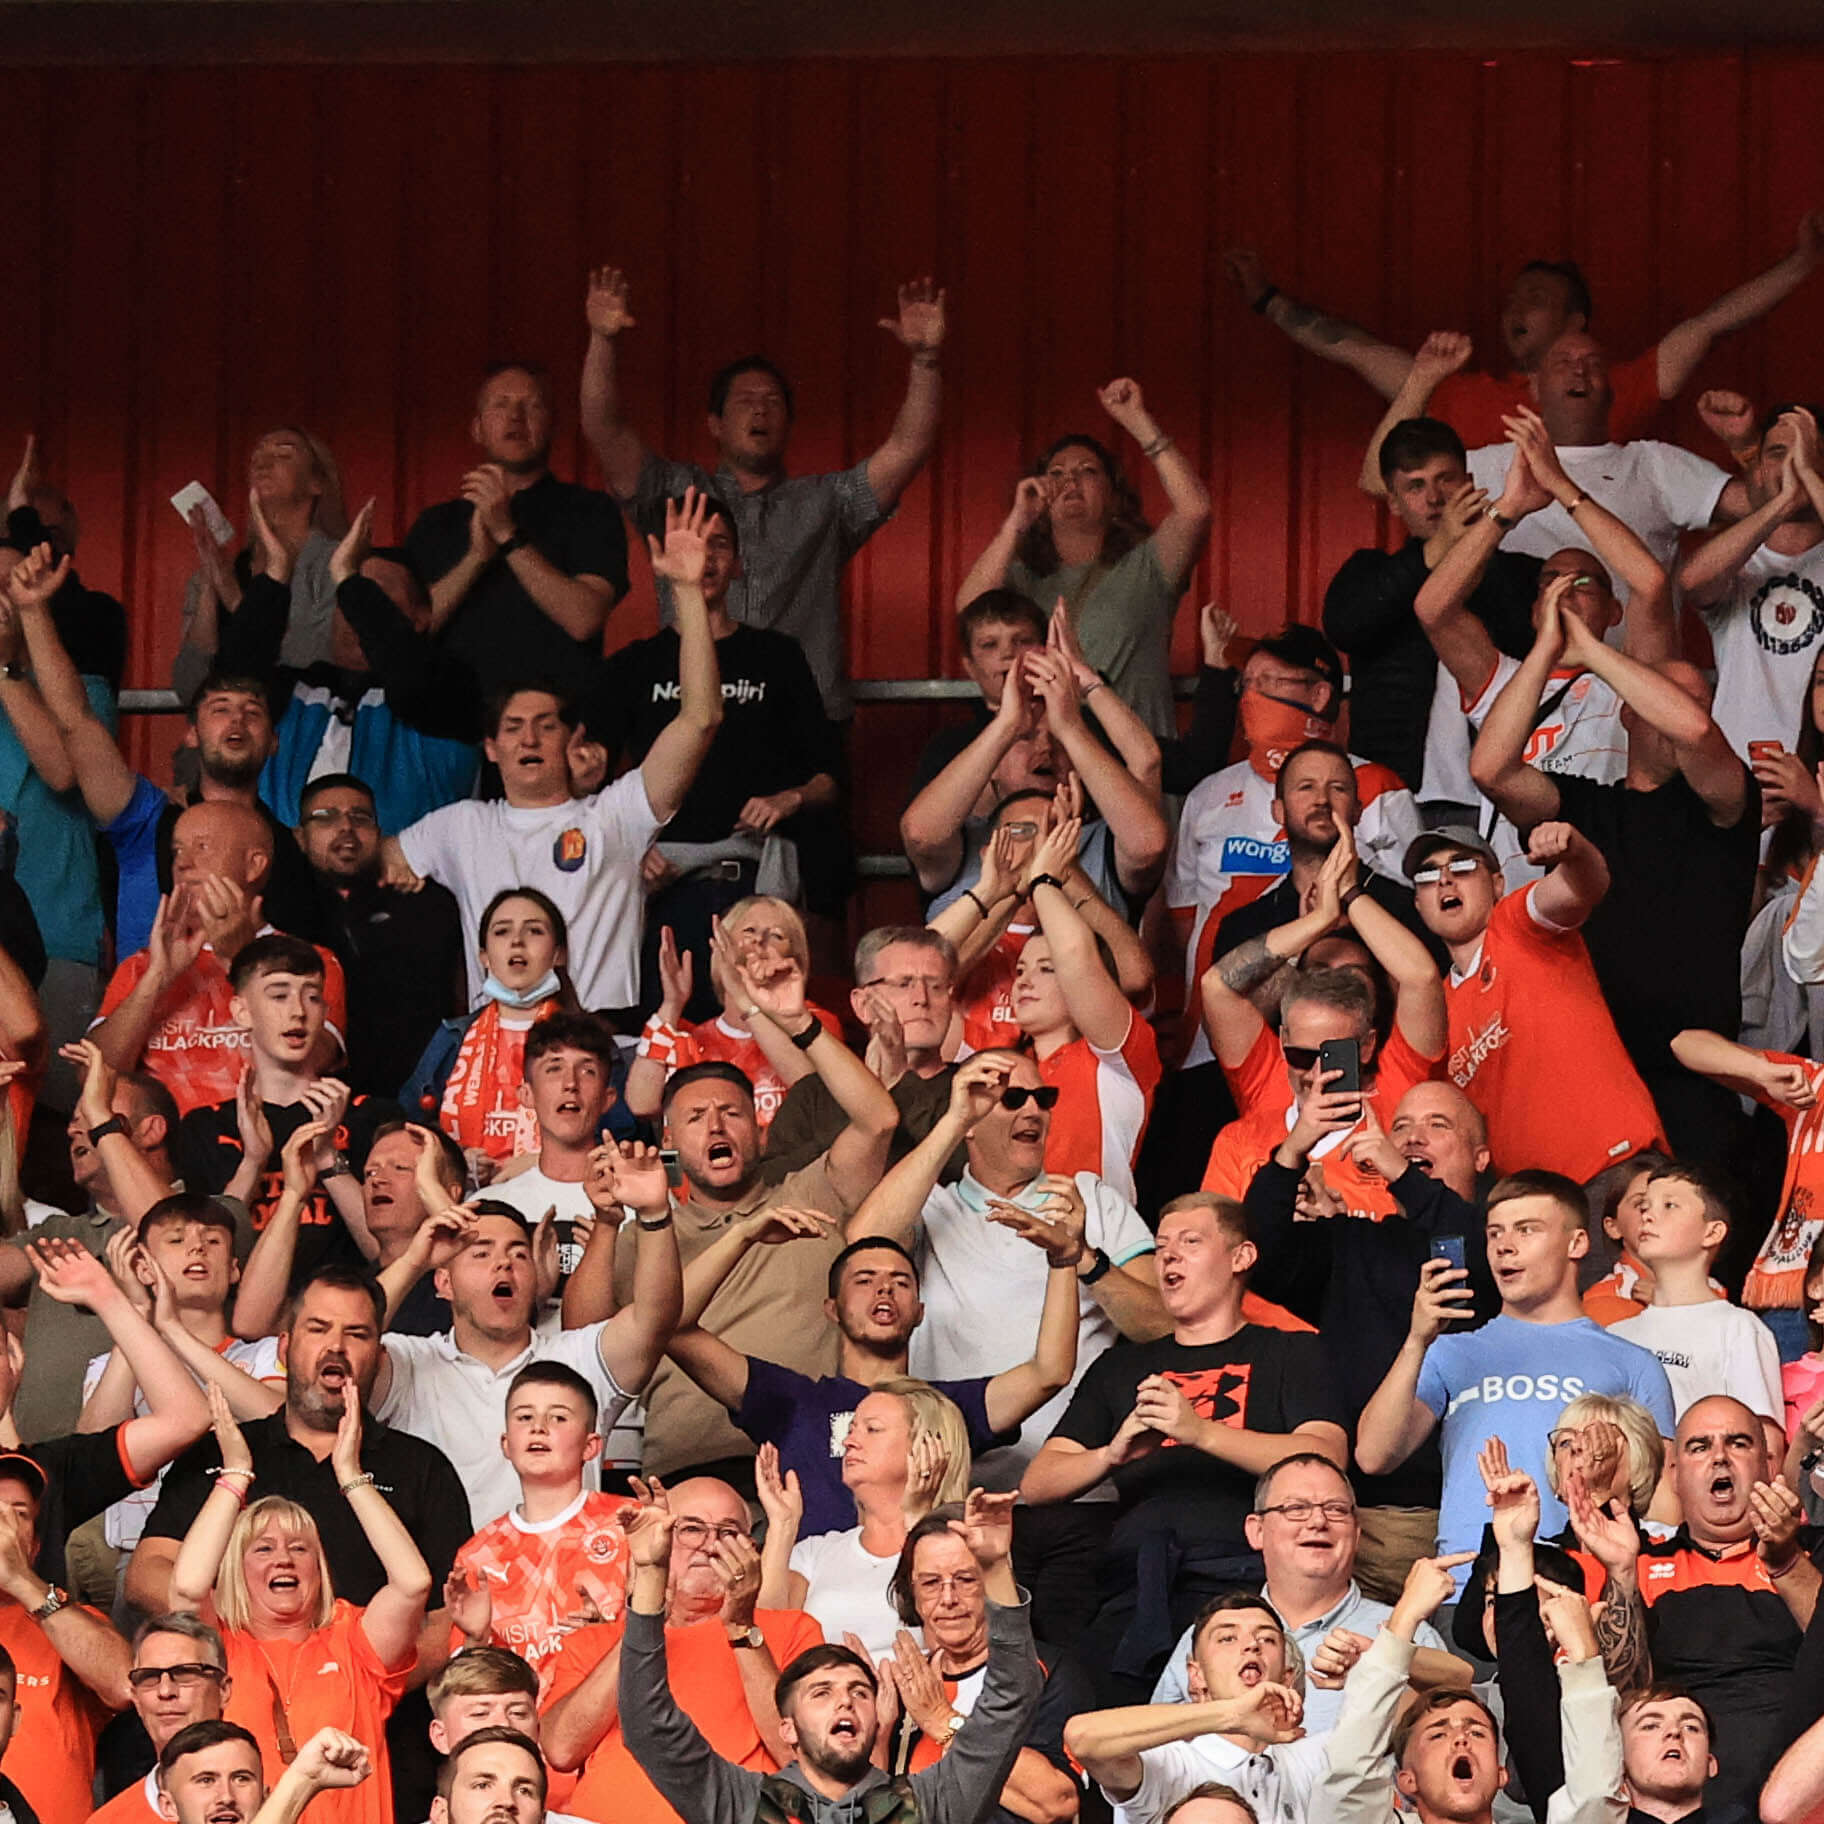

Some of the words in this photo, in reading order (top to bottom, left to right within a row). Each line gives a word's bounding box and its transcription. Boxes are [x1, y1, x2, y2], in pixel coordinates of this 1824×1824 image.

[1227, 839, 1290, 864] wong
[1482, 1374, 1583, 1402] BOSS
[16, 1673, 49, 1687] ERS
